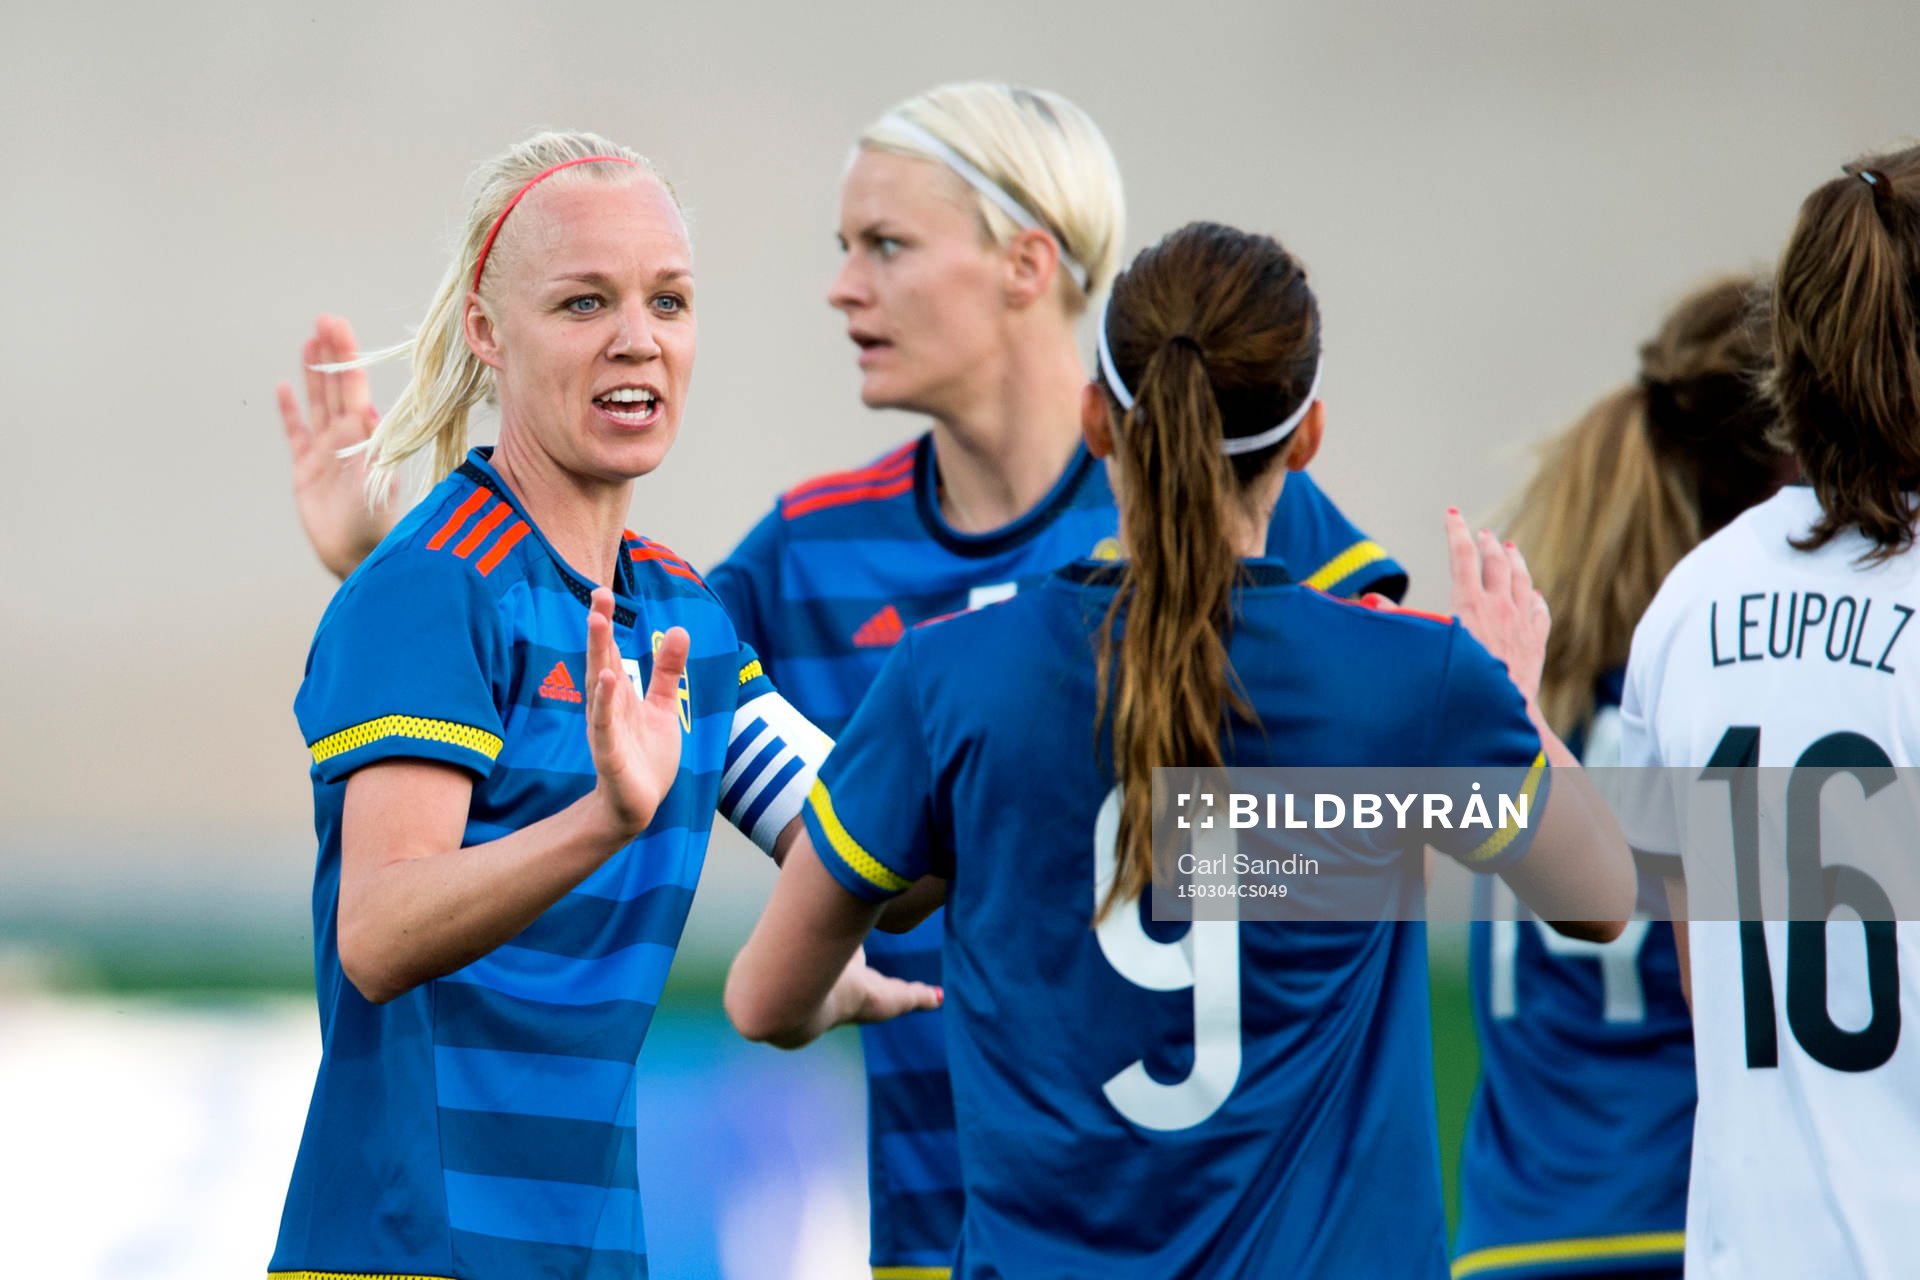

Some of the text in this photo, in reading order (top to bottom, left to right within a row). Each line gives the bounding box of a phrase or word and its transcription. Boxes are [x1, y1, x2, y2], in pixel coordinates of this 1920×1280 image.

[1710, 591, 1915, 674] LEUPOLZ
[1094, 780, 1242, 1131] 9
[1698, 726, 1902, 1072] 16
